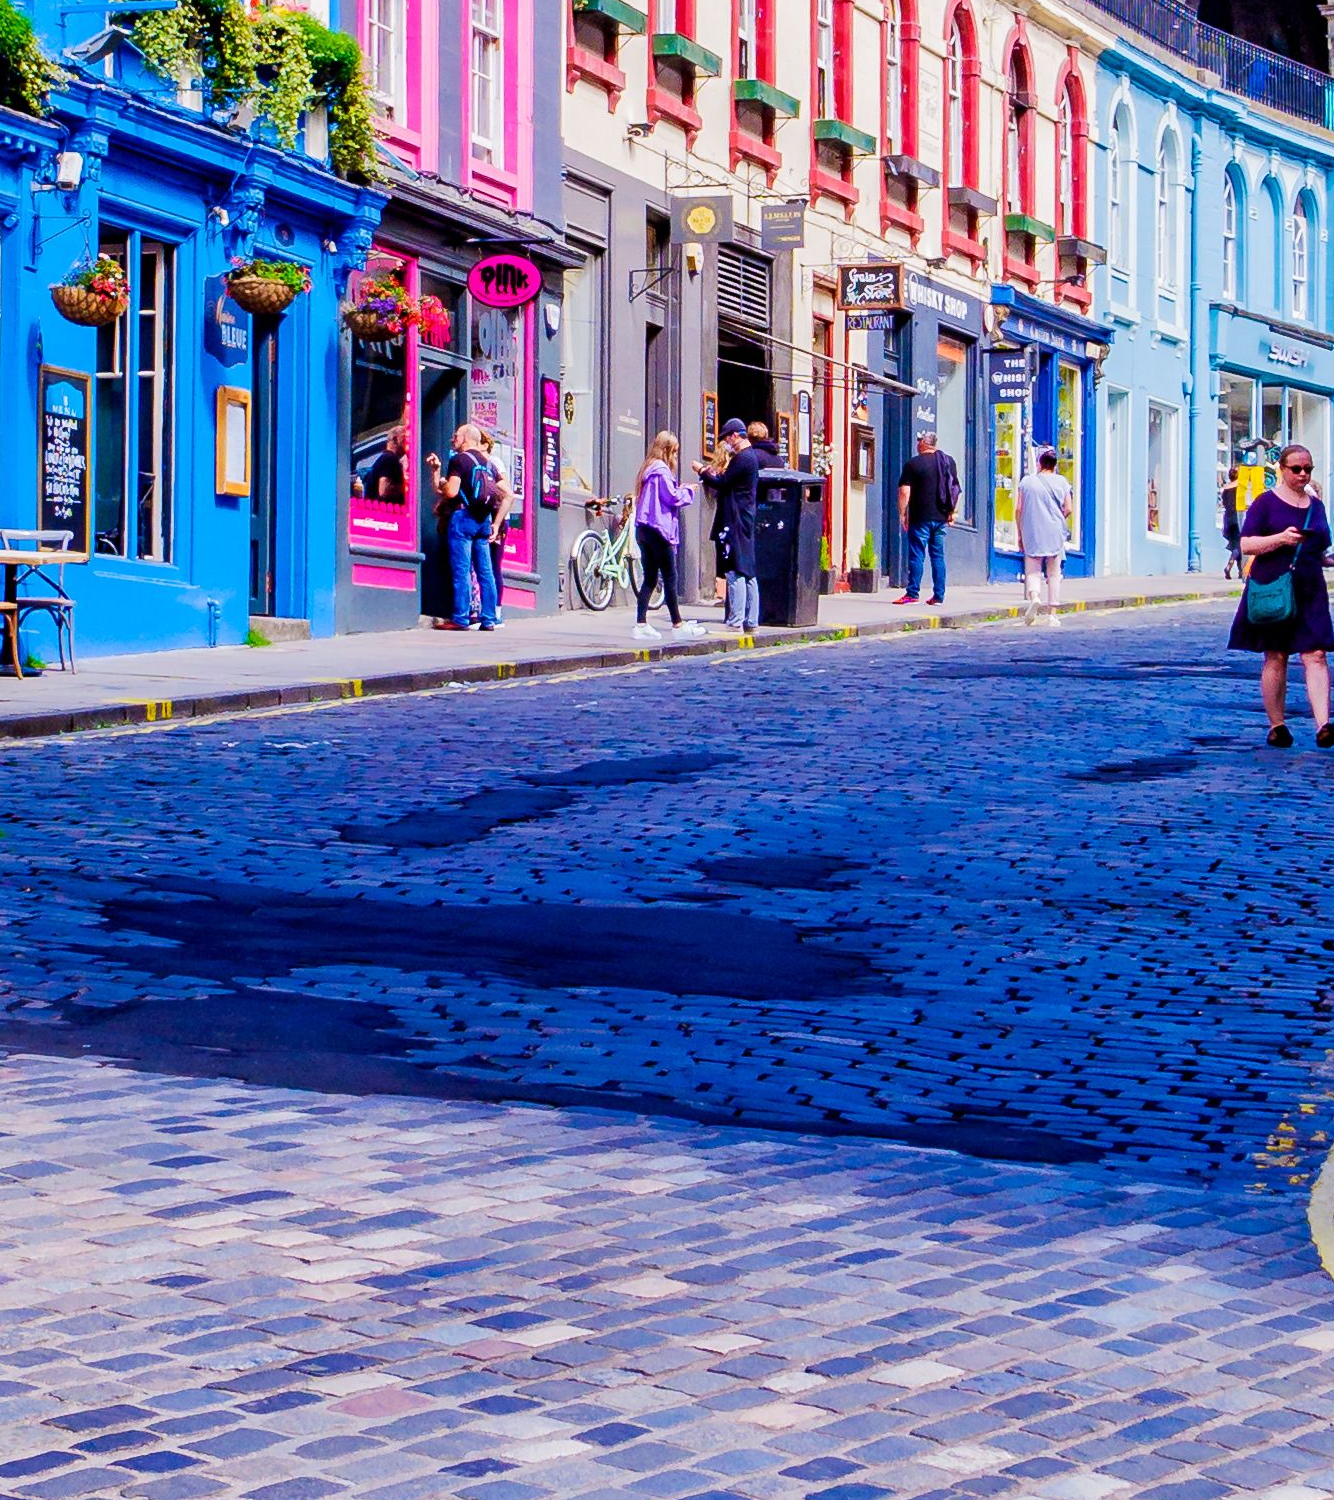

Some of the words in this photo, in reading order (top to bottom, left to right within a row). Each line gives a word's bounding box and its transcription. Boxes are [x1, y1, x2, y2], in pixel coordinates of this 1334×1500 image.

[908, 267, 945, 312] WHISKY
[944, 290, 968, 319] SHOP
[846, 315, 895, 330] RESTAURANT
[221, 324, 247, 350] BLEUE
[1003, 358, 1026, 368] THE
